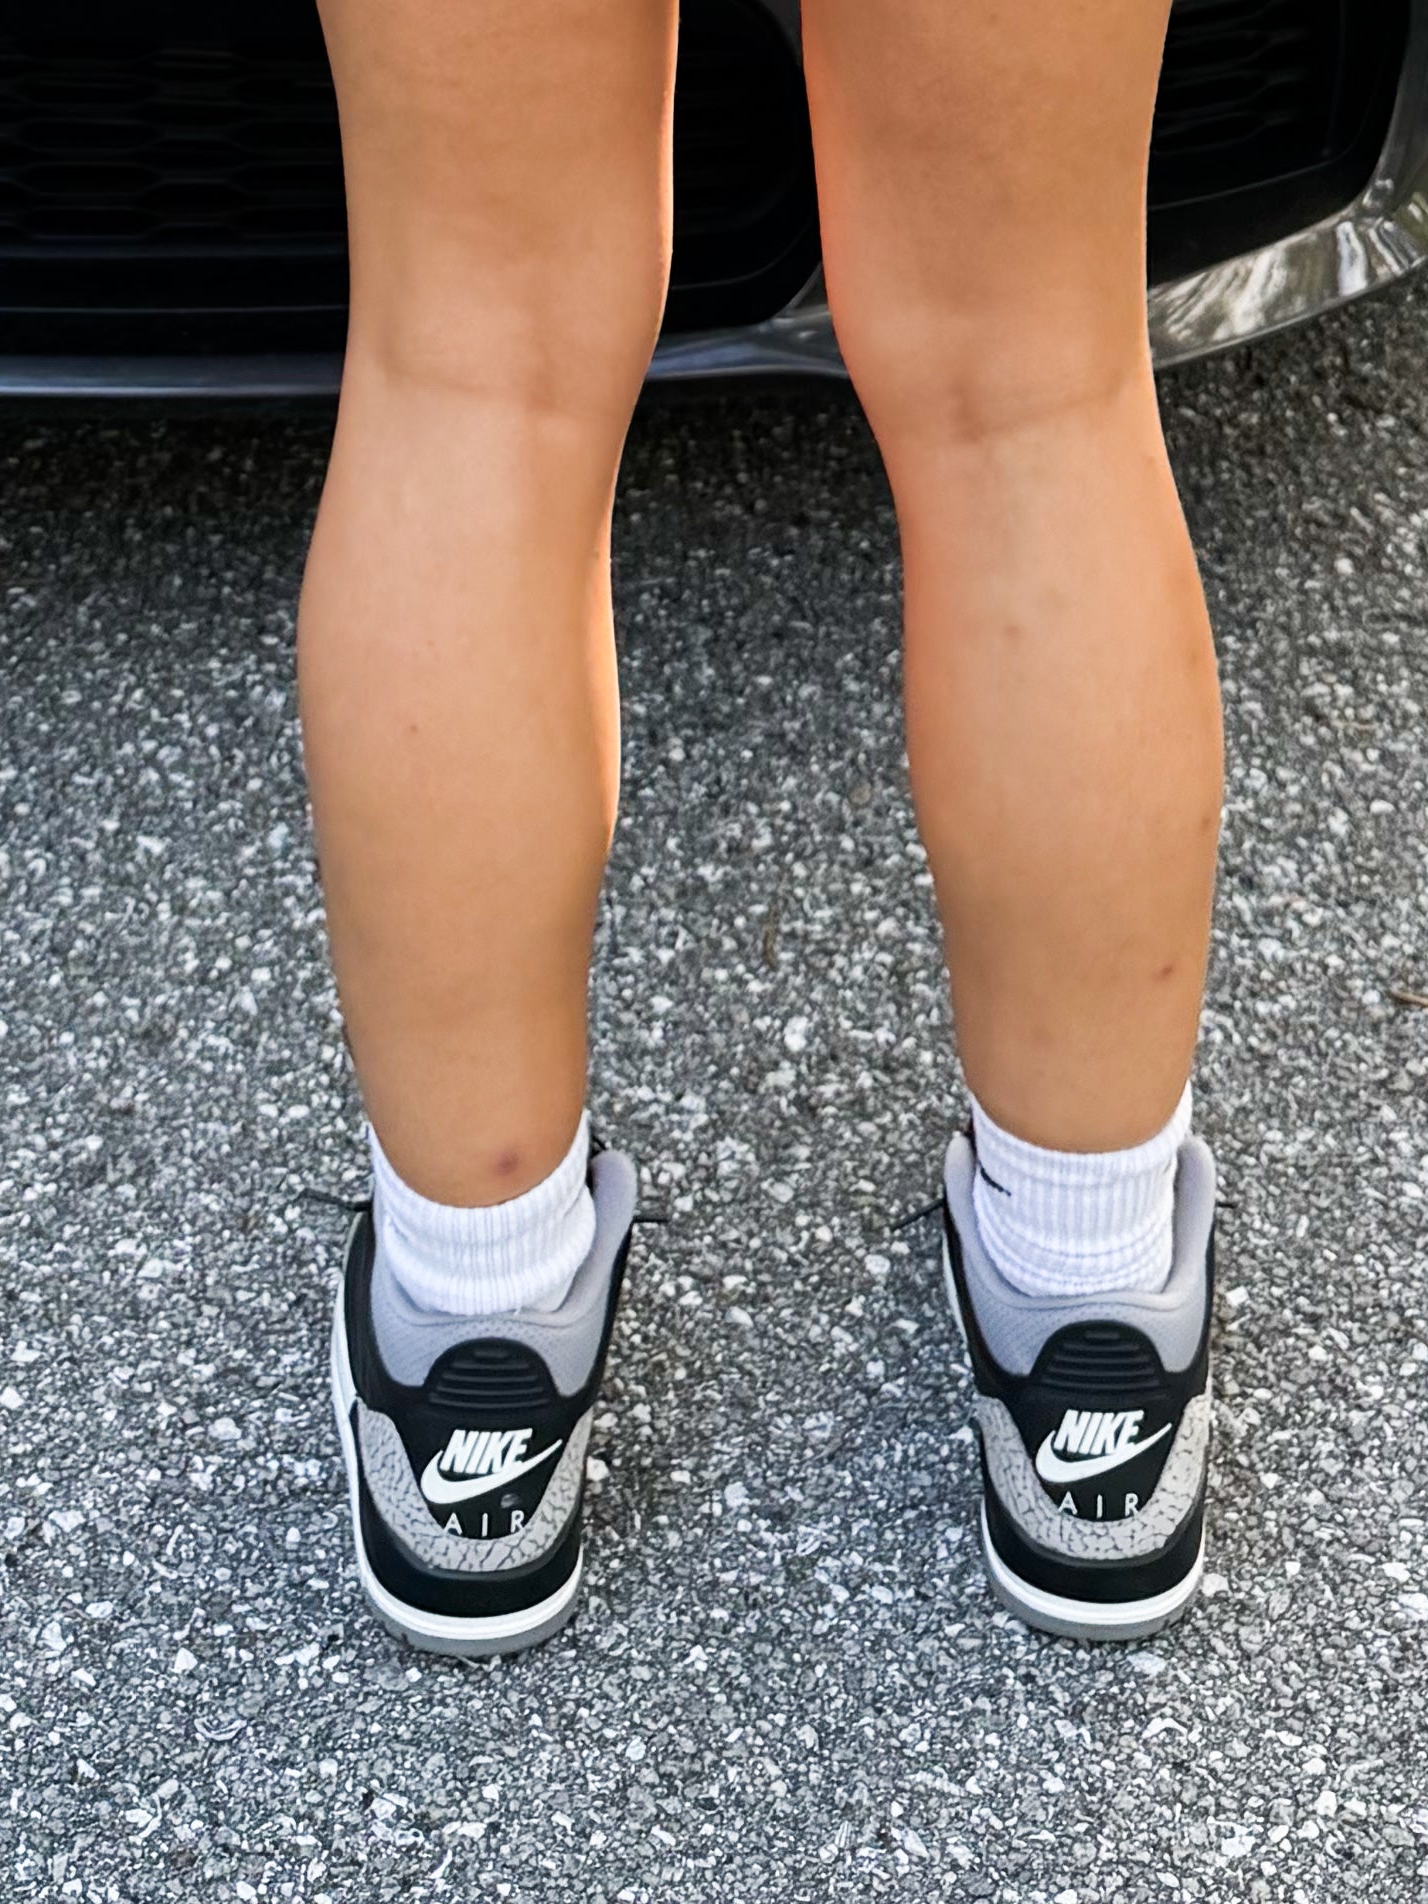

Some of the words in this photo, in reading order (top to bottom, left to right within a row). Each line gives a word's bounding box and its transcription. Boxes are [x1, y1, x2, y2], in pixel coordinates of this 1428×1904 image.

[438, 1427, 533, 1475] NIKE
[1052, 1408, 1145, 1456] NIKE
[442, 1509, 526, 1538] AIR
[1057, 1490, 1140, 1519] AIR
